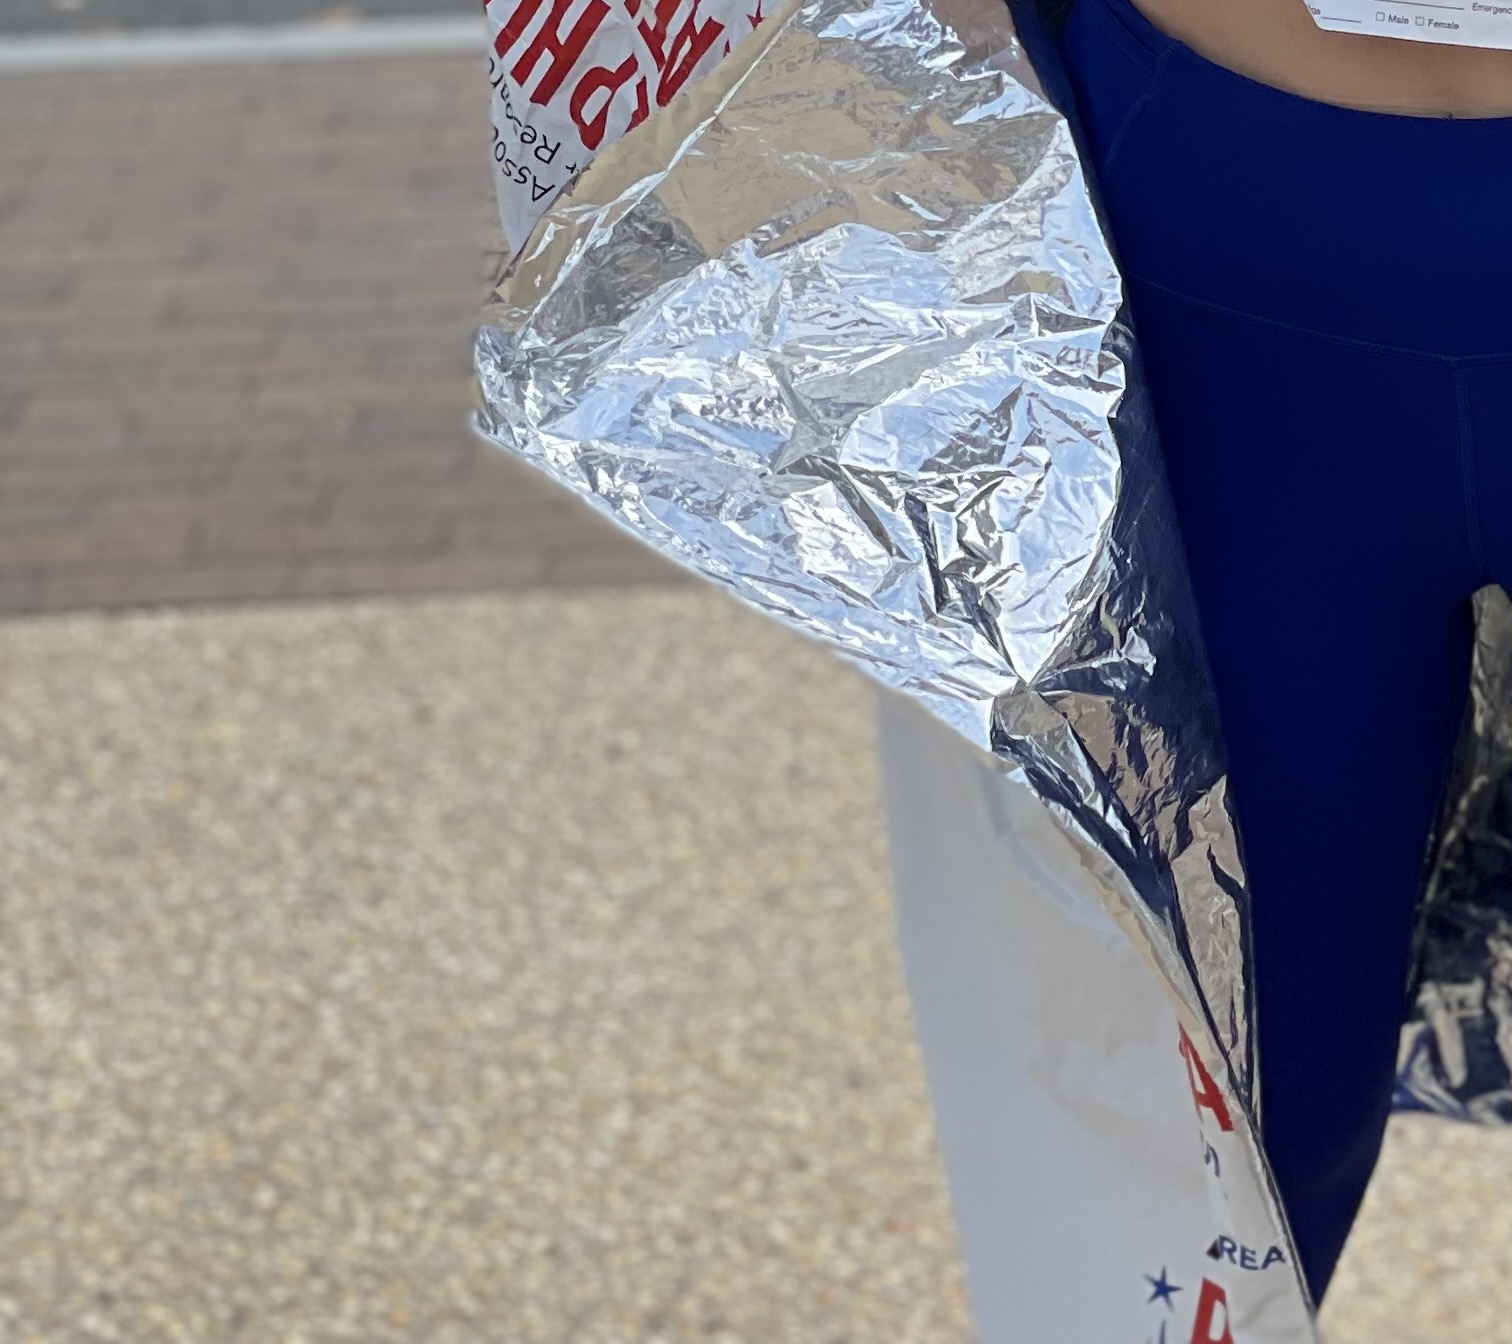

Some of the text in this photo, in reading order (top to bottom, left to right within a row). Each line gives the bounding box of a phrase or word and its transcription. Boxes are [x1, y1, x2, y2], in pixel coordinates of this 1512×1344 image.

[1308, 5, 1460, 30] ge Male Female
